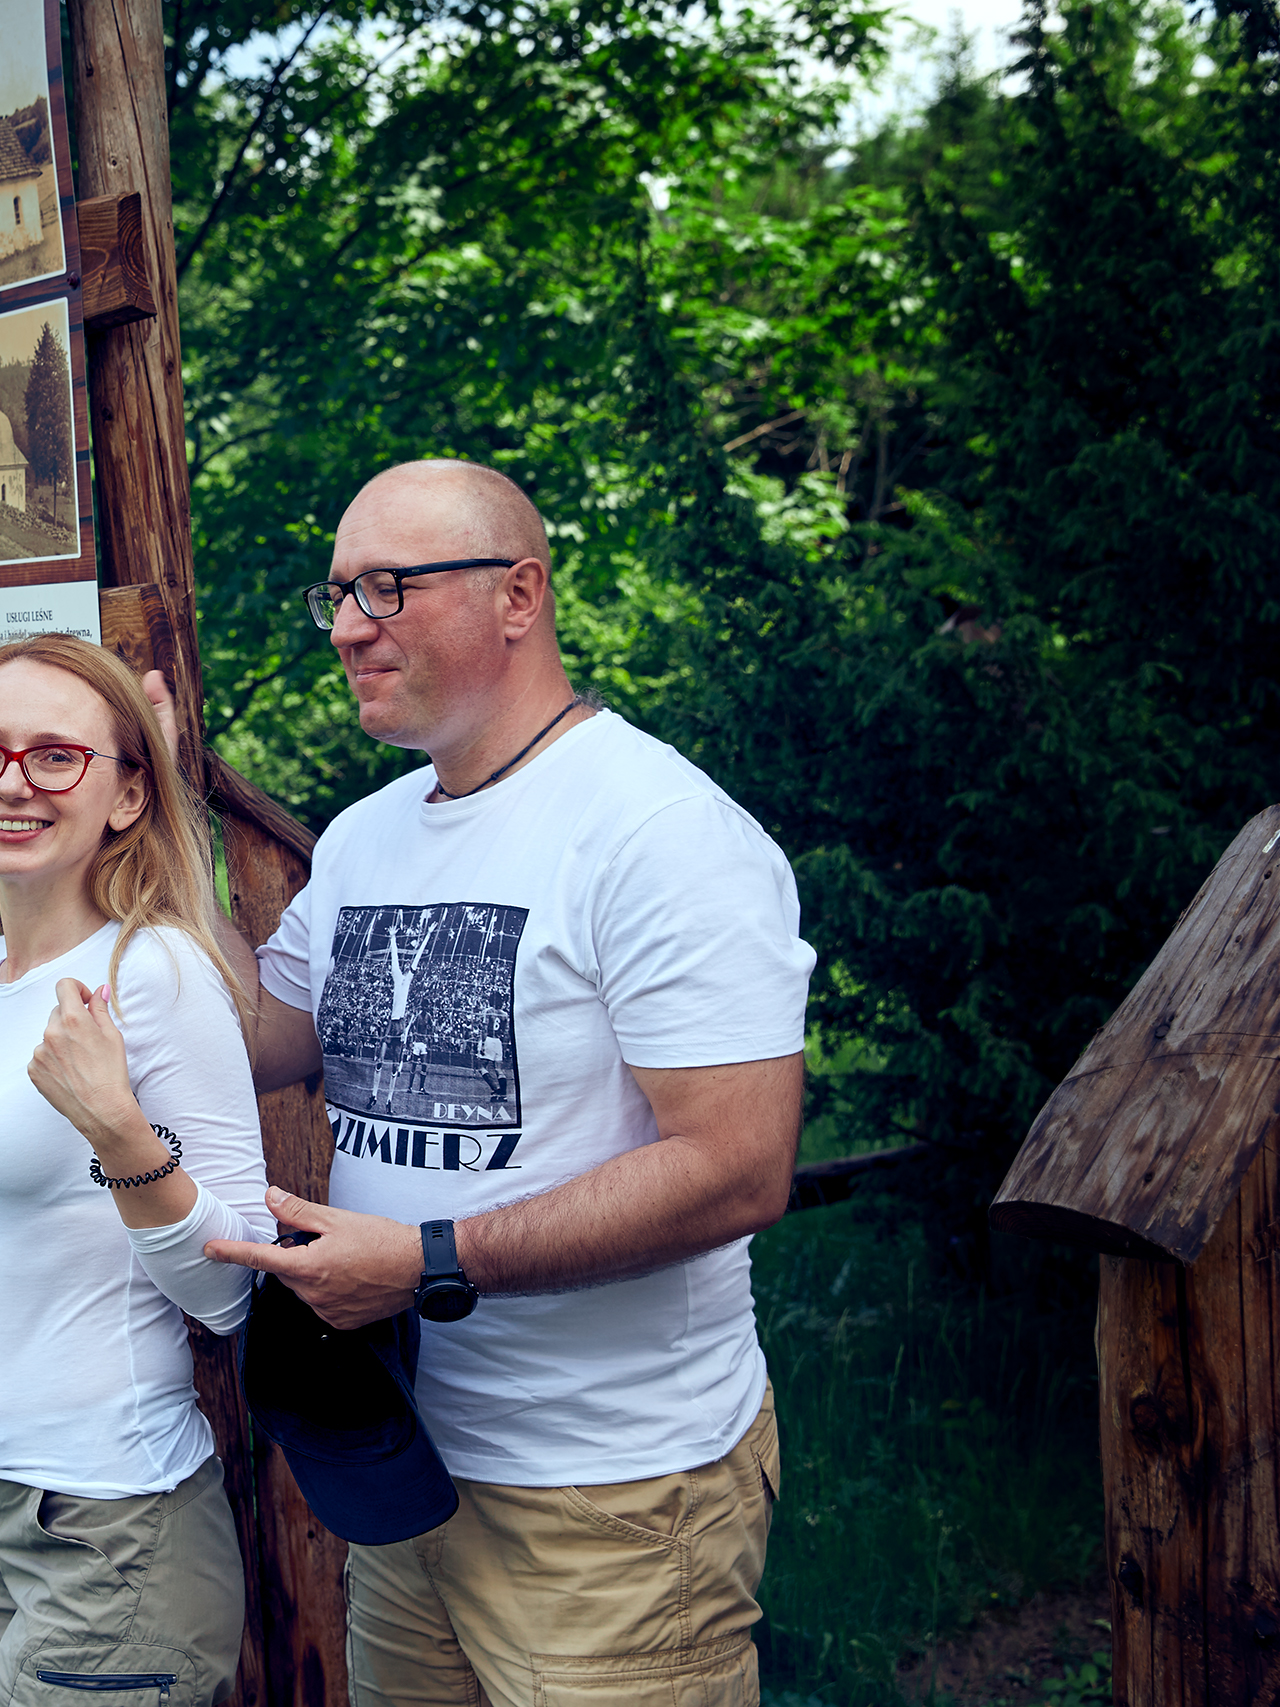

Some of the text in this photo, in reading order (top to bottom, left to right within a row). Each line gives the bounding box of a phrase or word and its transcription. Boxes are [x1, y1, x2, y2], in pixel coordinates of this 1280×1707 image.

[6, 608, 53, 623] USŁUGI LEŚNE
[433, 1102, 511, 1122] DEYNA
